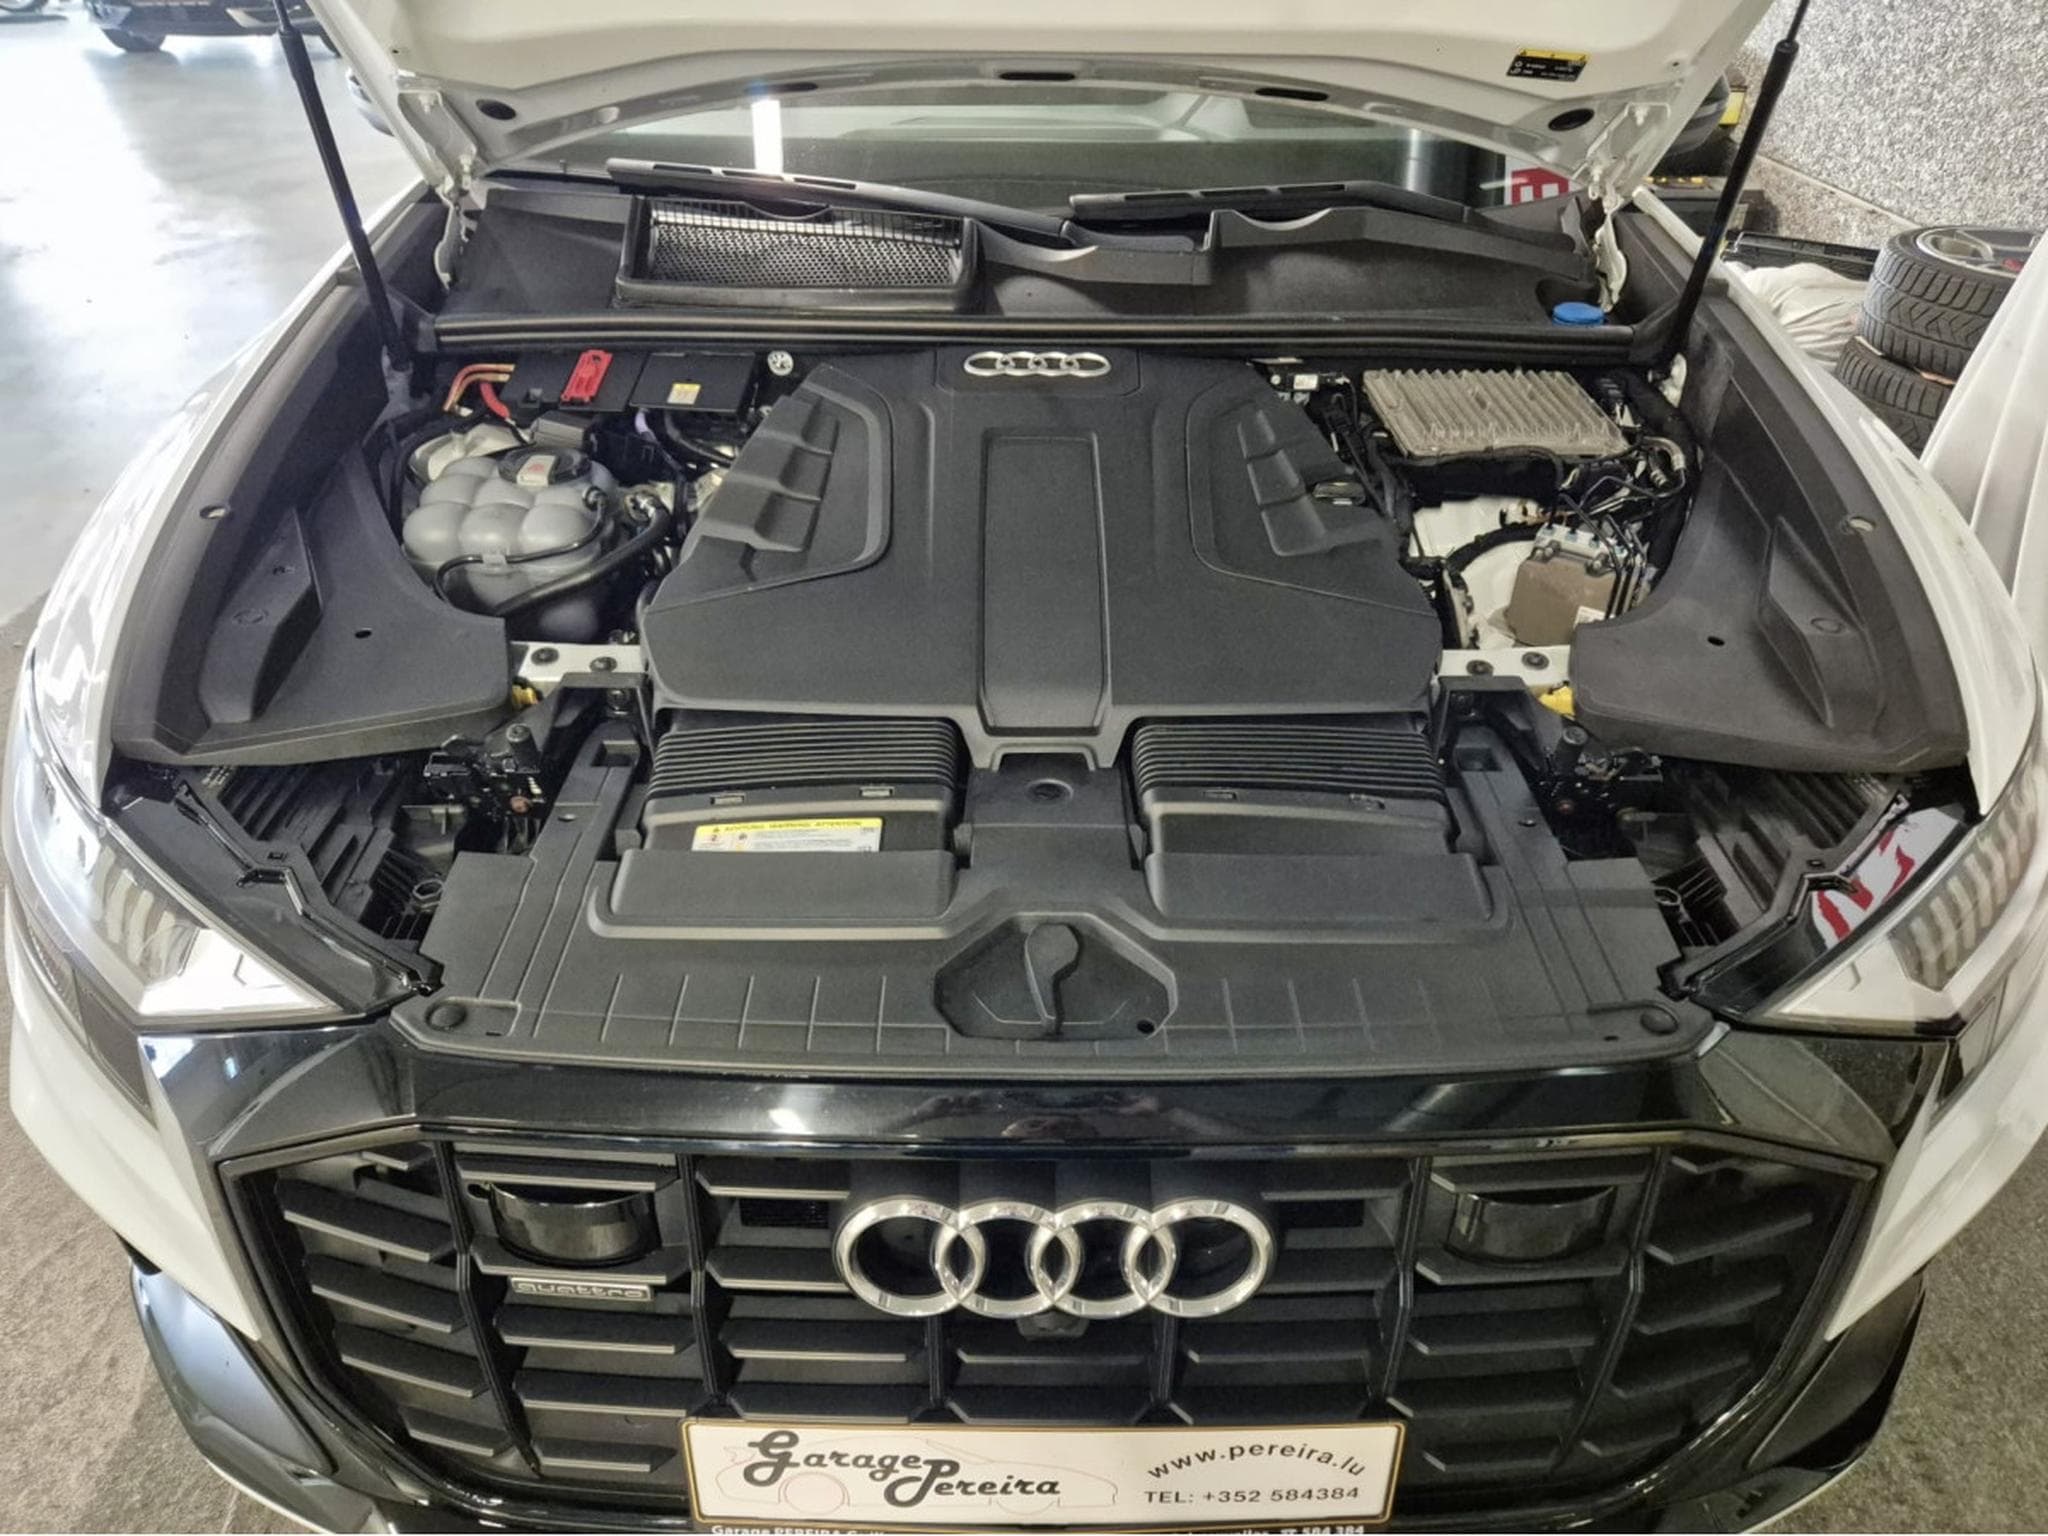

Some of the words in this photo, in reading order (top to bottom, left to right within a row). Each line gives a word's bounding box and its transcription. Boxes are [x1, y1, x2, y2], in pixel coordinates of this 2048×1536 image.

[518, 1282, 644, 1299] quattro
[743, 1430, 922, 1487] Garage
[1148, 1443, 1366, 1479] www.pereira.lu
[884, 1459, 1060, 1508] Pereira
[1144, 1490, 1194, 1504] TEL:
[1203, 1490, 1261, 1503] +352
[1270, 1487, 1359, 1501] 584384
